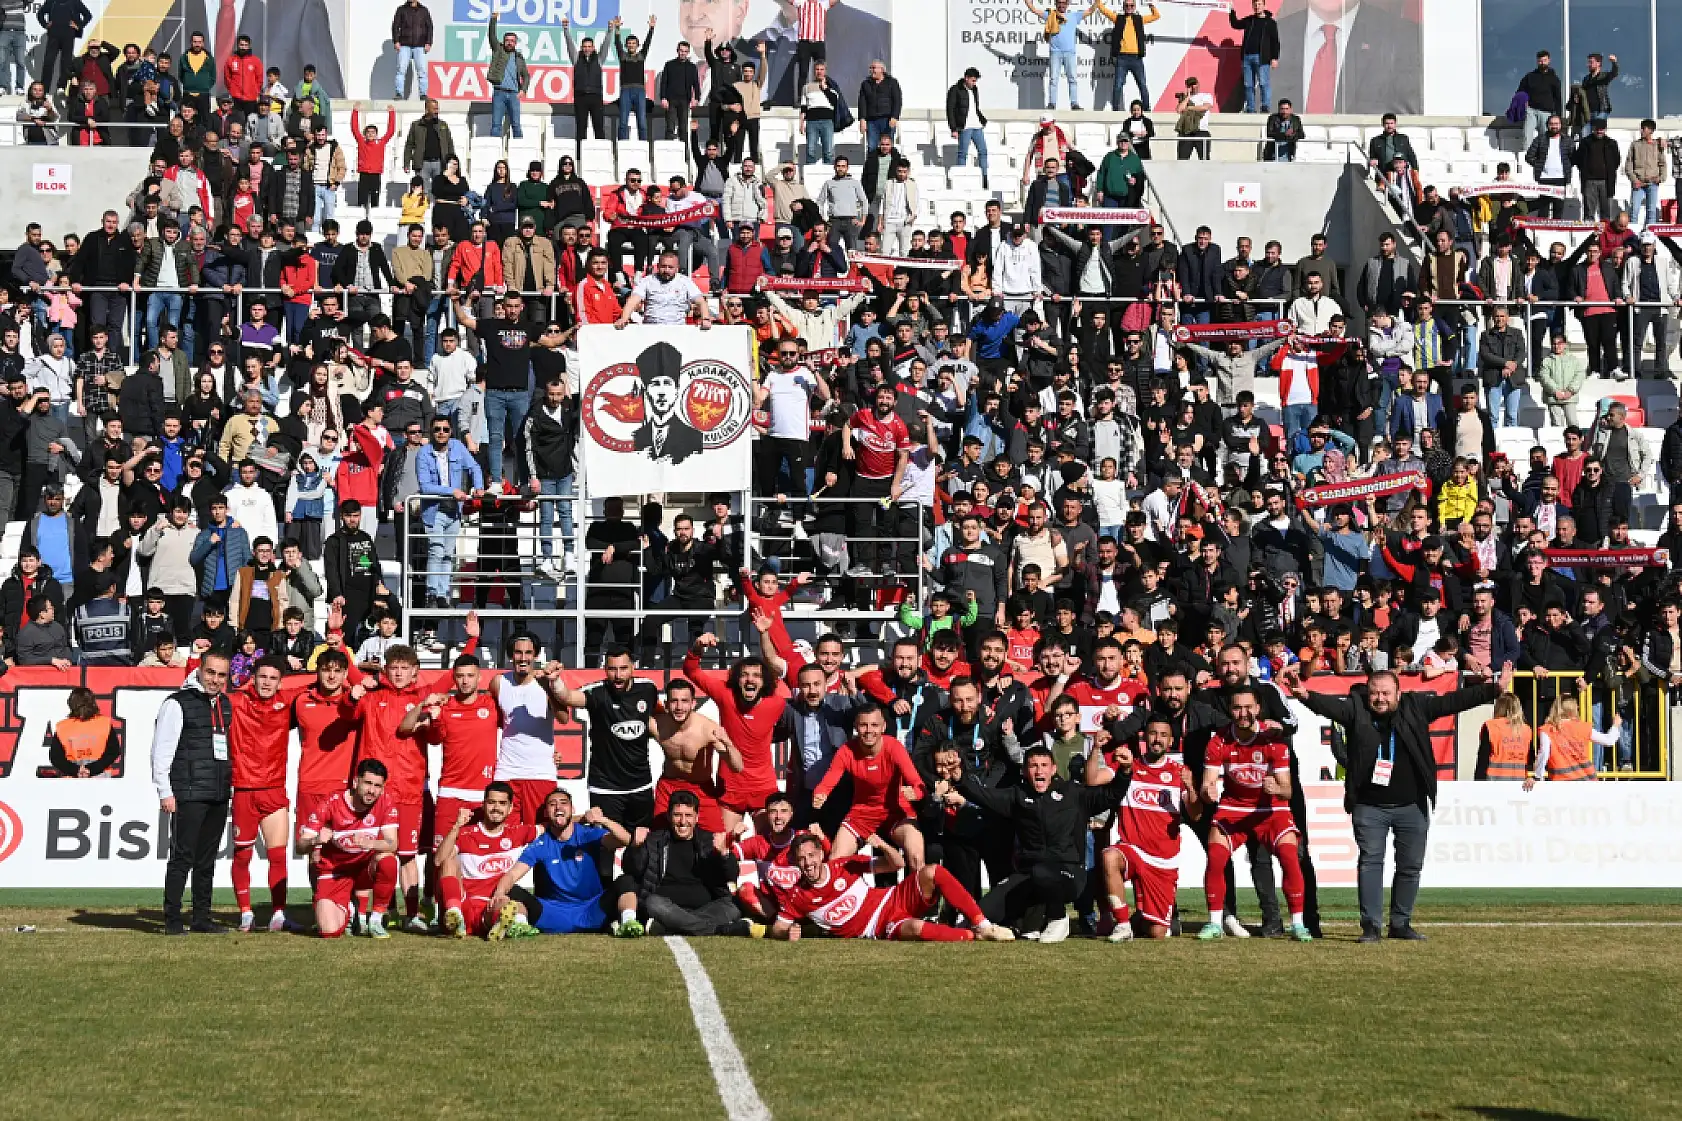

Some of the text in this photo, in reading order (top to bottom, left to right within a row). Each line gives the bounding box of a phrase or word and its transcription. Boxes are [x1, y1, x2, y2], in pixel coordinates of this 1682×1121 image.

[48, 168, 56, 177] E
[35, 182, 67, 190] BLOK
[1238, 186, 1245, 195] F
[1227, 200, 1257, 208] BLOK
